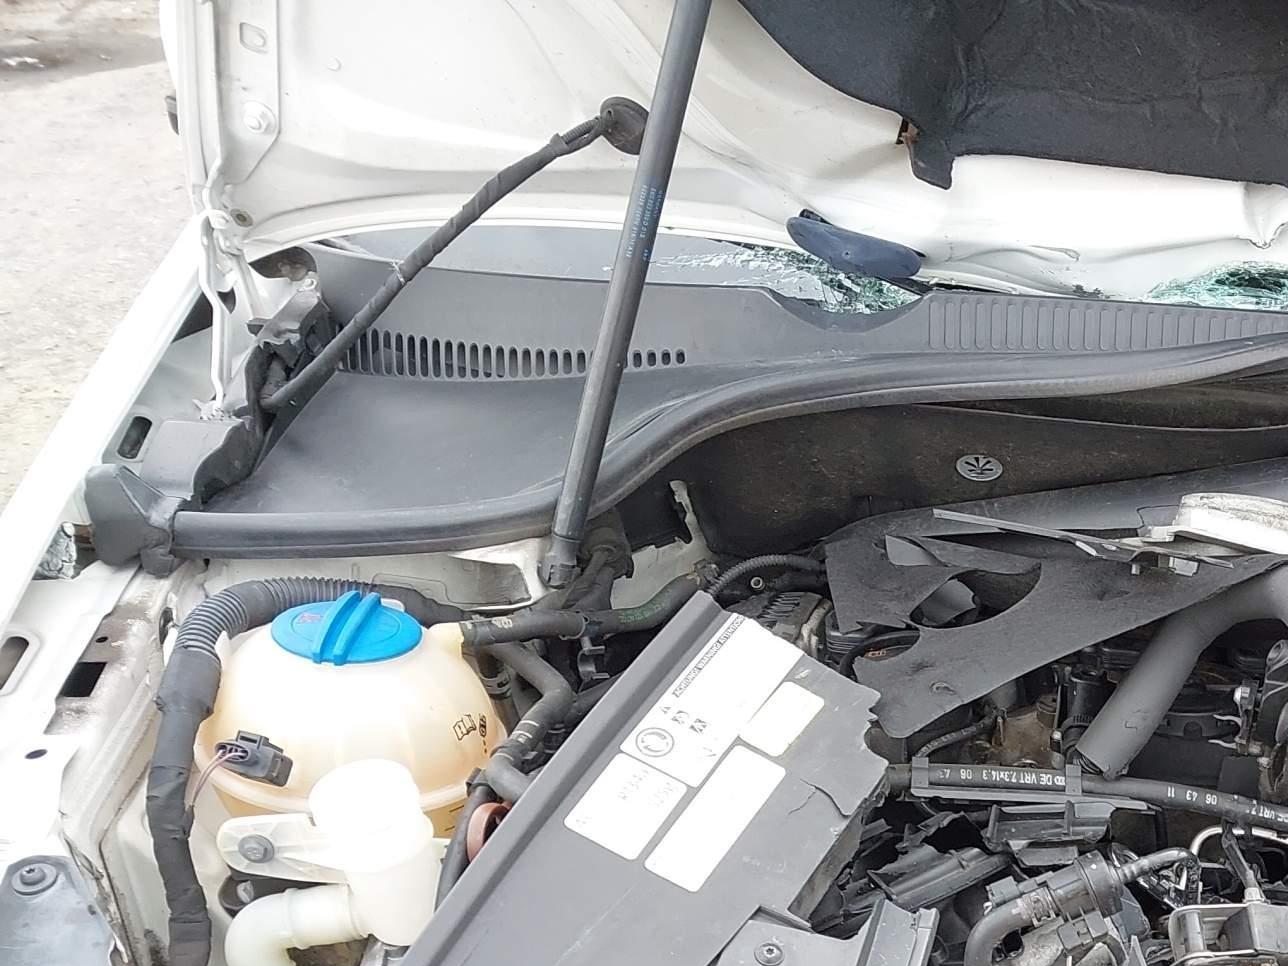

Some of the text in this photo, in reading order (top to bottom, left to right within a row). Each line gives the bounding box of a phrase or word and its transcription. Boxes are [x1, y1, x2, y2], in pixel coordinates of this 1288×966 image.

[960, 769, 973, 780] 06
[982, 769, 1017, 783] 7.3x14.3
[1020, 772, 1037, 784] VRT
[1040, 773, 1052, 785] DE
[1186, 790, 1198, 801] 43
[1205, 793, 1217, 805] 06
